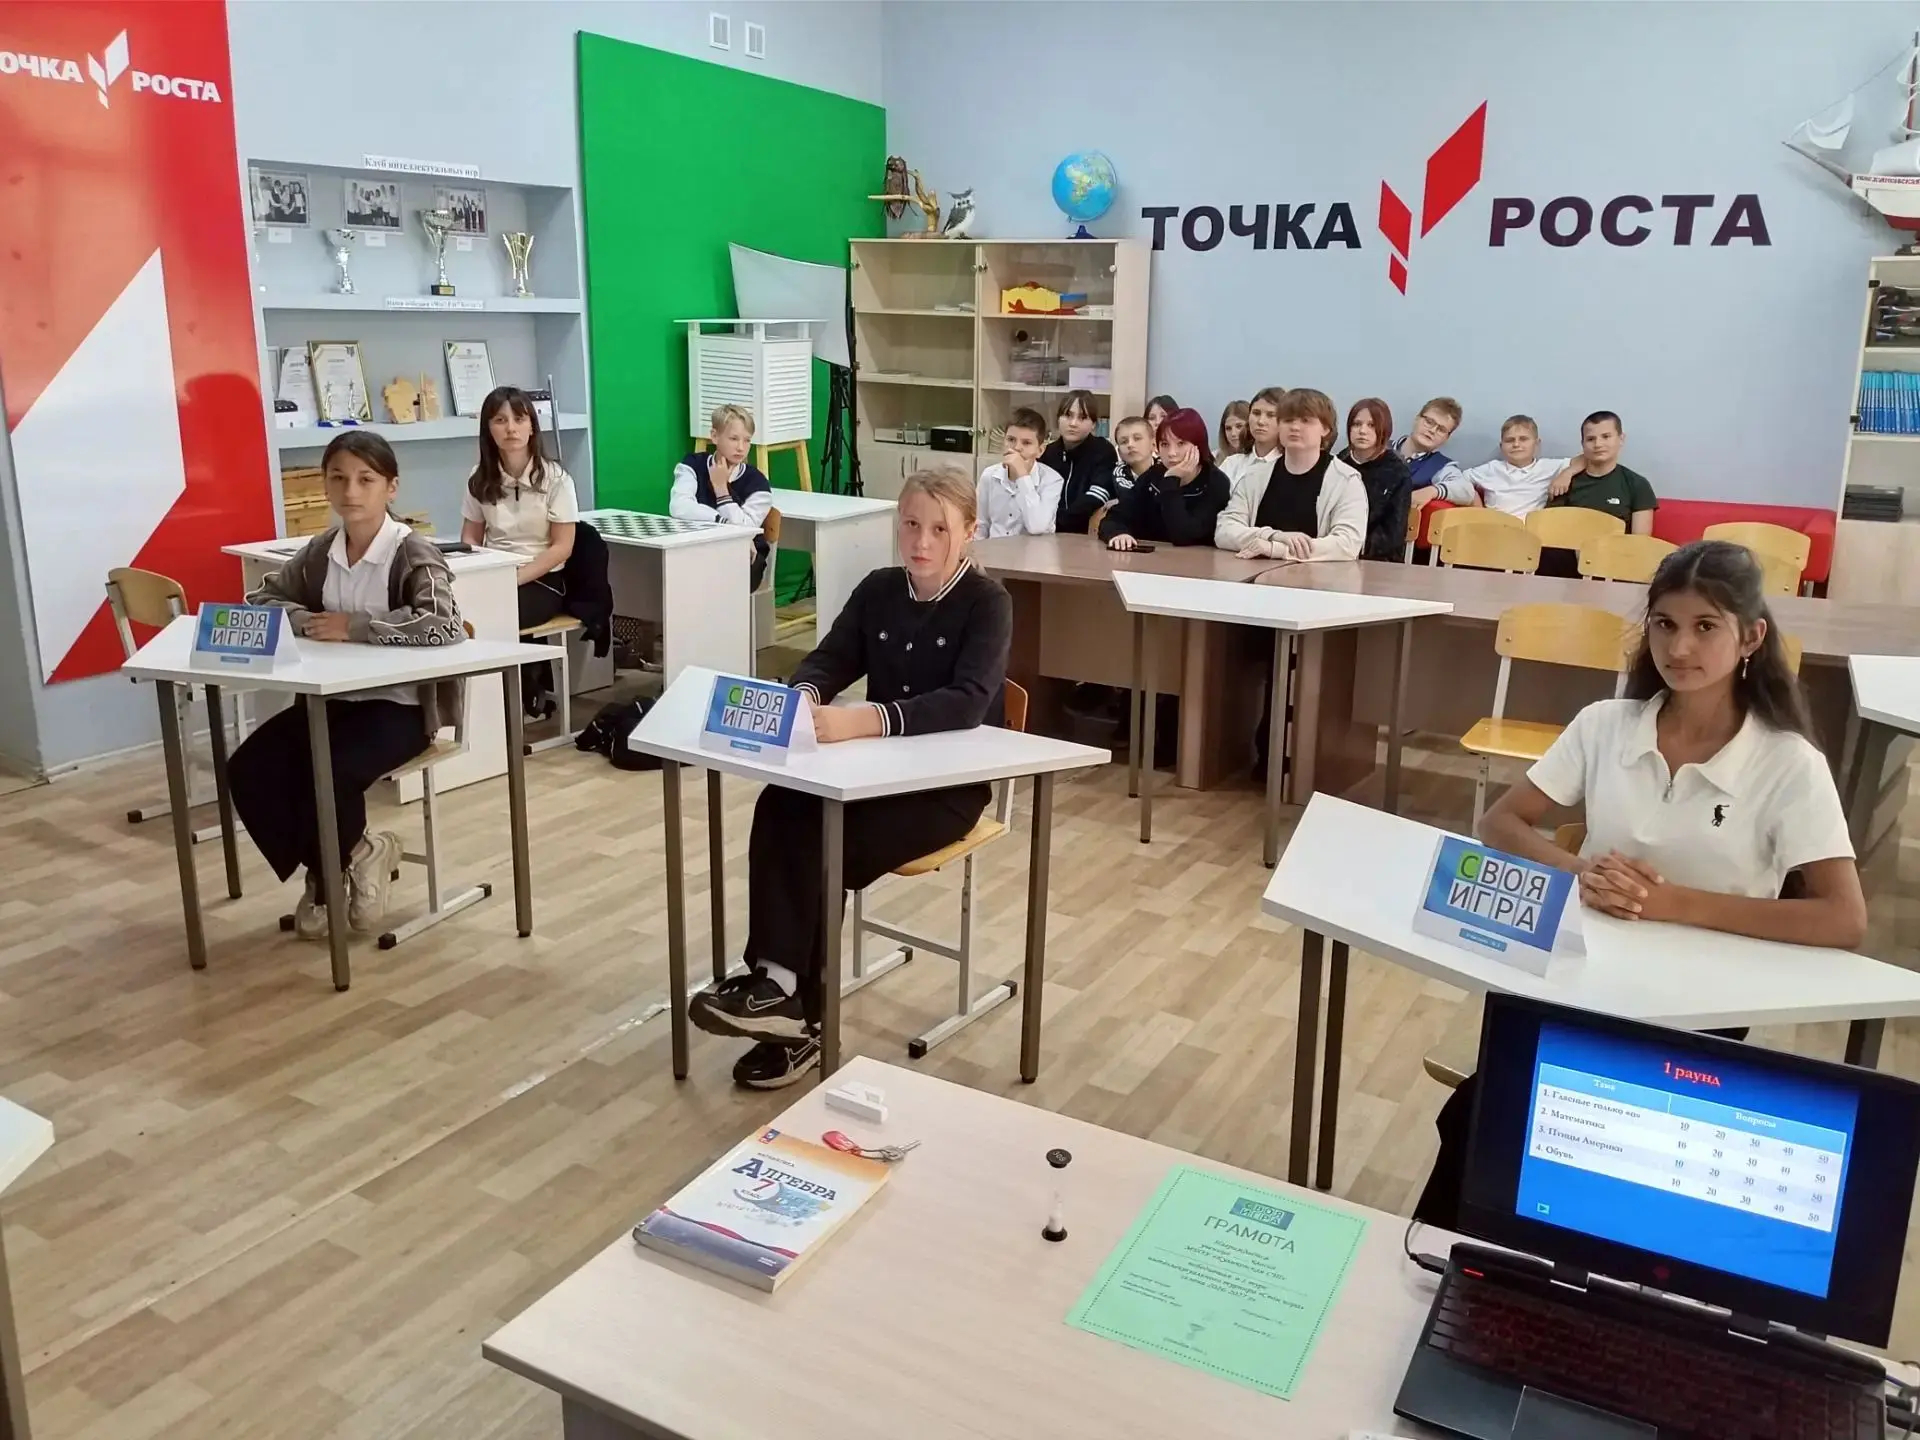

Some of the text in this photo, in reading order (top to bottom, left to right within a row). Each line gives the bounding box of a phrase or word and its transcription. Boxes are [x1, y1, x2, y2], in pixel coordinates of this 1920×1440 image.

[0, 51, 222, 103] ОЧКА РОСТА
[365, 157, 479, 178] Клуб интеллектуальных игр
[1141, 194, 1772, 251] ТОЧКА РОСТА
[216, 610, 268, 628] СВОЯ
[212, 629, 266, 648] ИГРА
[729, 686, 785, 713] СВОЯ
[723, 708, 779, 736] ИГРА
[1460, 855, 1547, 901] СВОЯ
[1450, 883, 1535, 932] ИГРА
[1664, 1061, 1721, 1087] 1 раунд
[1543, 1088, 1550, 1097] 1.
[1552, 1090, 1591, 1107] Гласные
[1593, 1102, 1624, 1116] только
[1540, 1107, 1606, 1130] 2. Математика
[1735, 1112, 1777, 1128] Вопросы
[1538, 1125, 1624, 1153] 3. Птицы Америки
[1680, 1121, 1690, 1131] 10
[1715, 1130, 1726, 1141] 20
[1750, 1138, 1761, 1148] 30
[1535, 1144, 1574, 1160] 4. Обувь
[1712, 1149, 1723, 1159] 20
[1814, 1173, 1826, 1183] 50
[752, 1178, 776, 1192] 7
[1674, 1159, 1684, 1169] 10
[1709, 1167, 1720, 1178] 20
[1776, 1184, 1788, 1194] 40
[1811, 1193, 1823, 1203] 50
[1671, 1178, 1820, 1222] 10 20 30 40 50
[1203, 1215, 1295, 1253] ГРАМОТА
